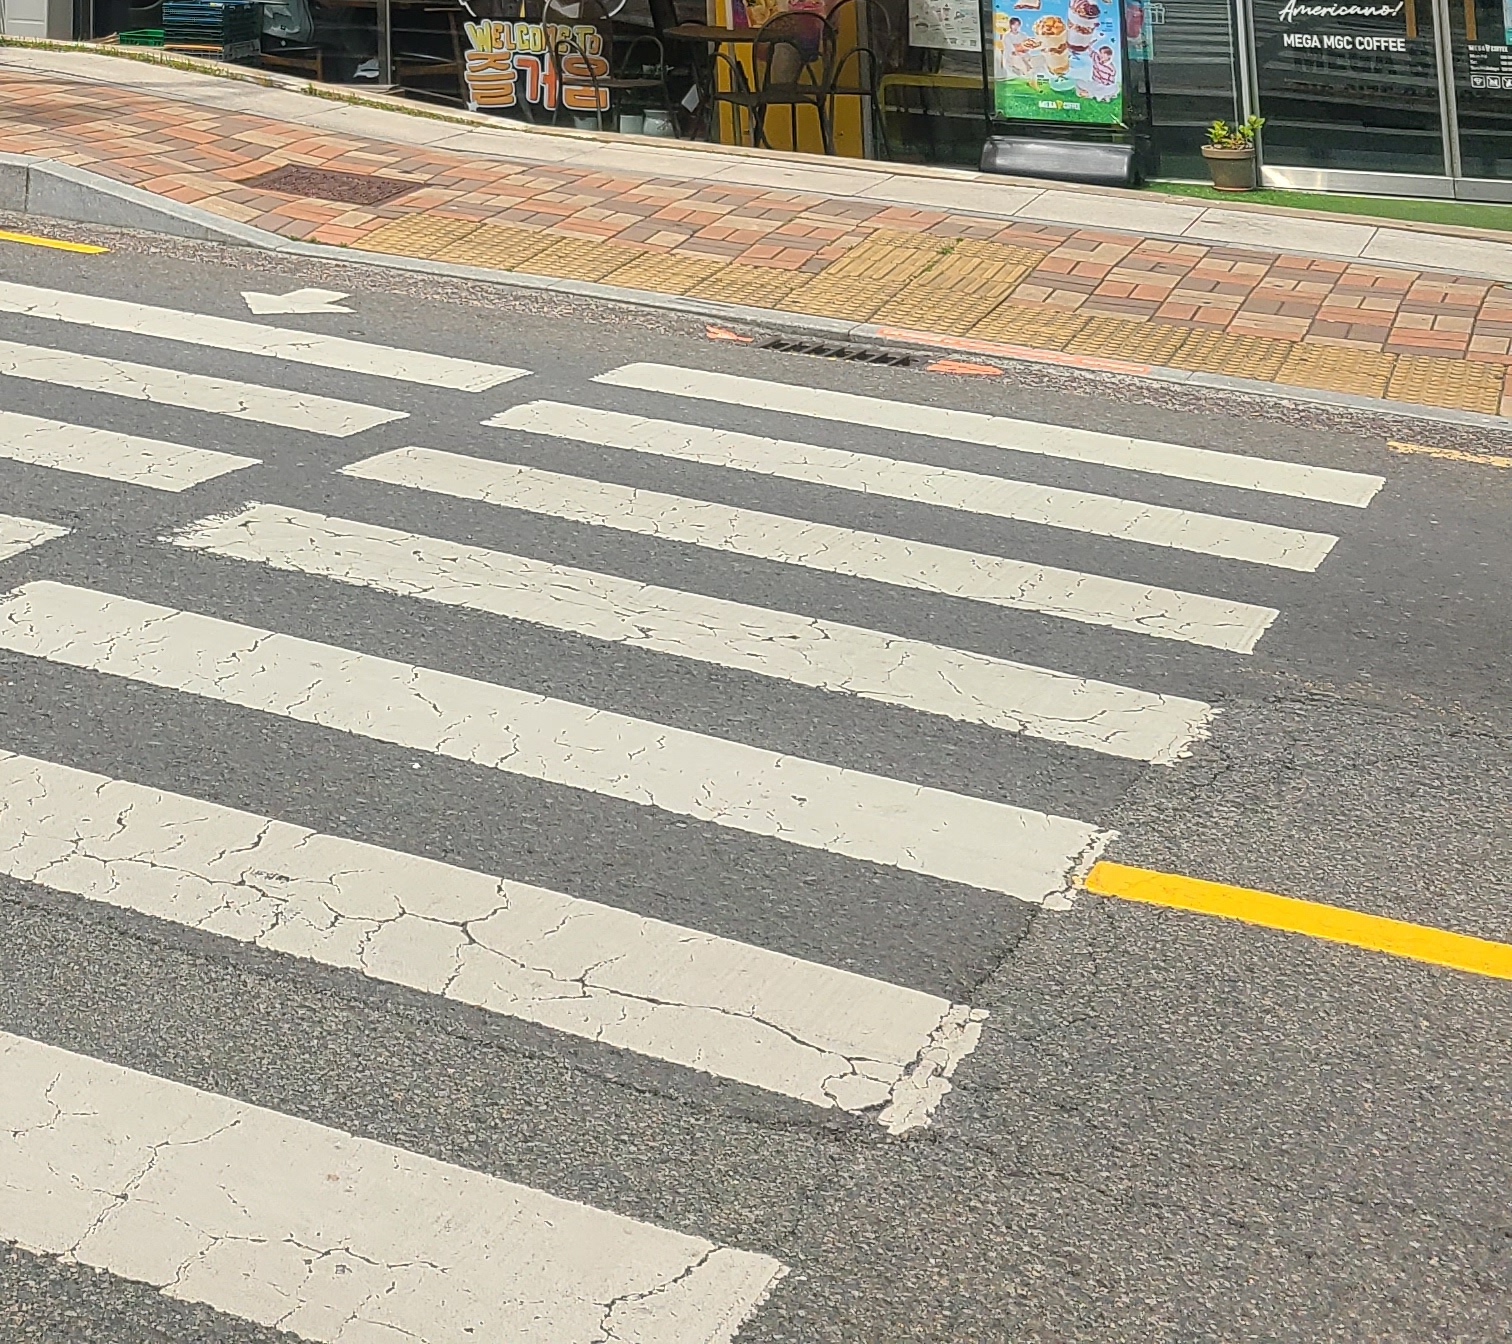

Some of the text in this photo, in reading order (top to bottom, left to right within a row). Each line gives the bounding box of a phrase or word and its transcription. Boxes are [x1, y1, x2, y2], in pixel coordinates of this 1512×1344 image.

[1283, 33, 1406, 52] MEGA MGC COFFEE
